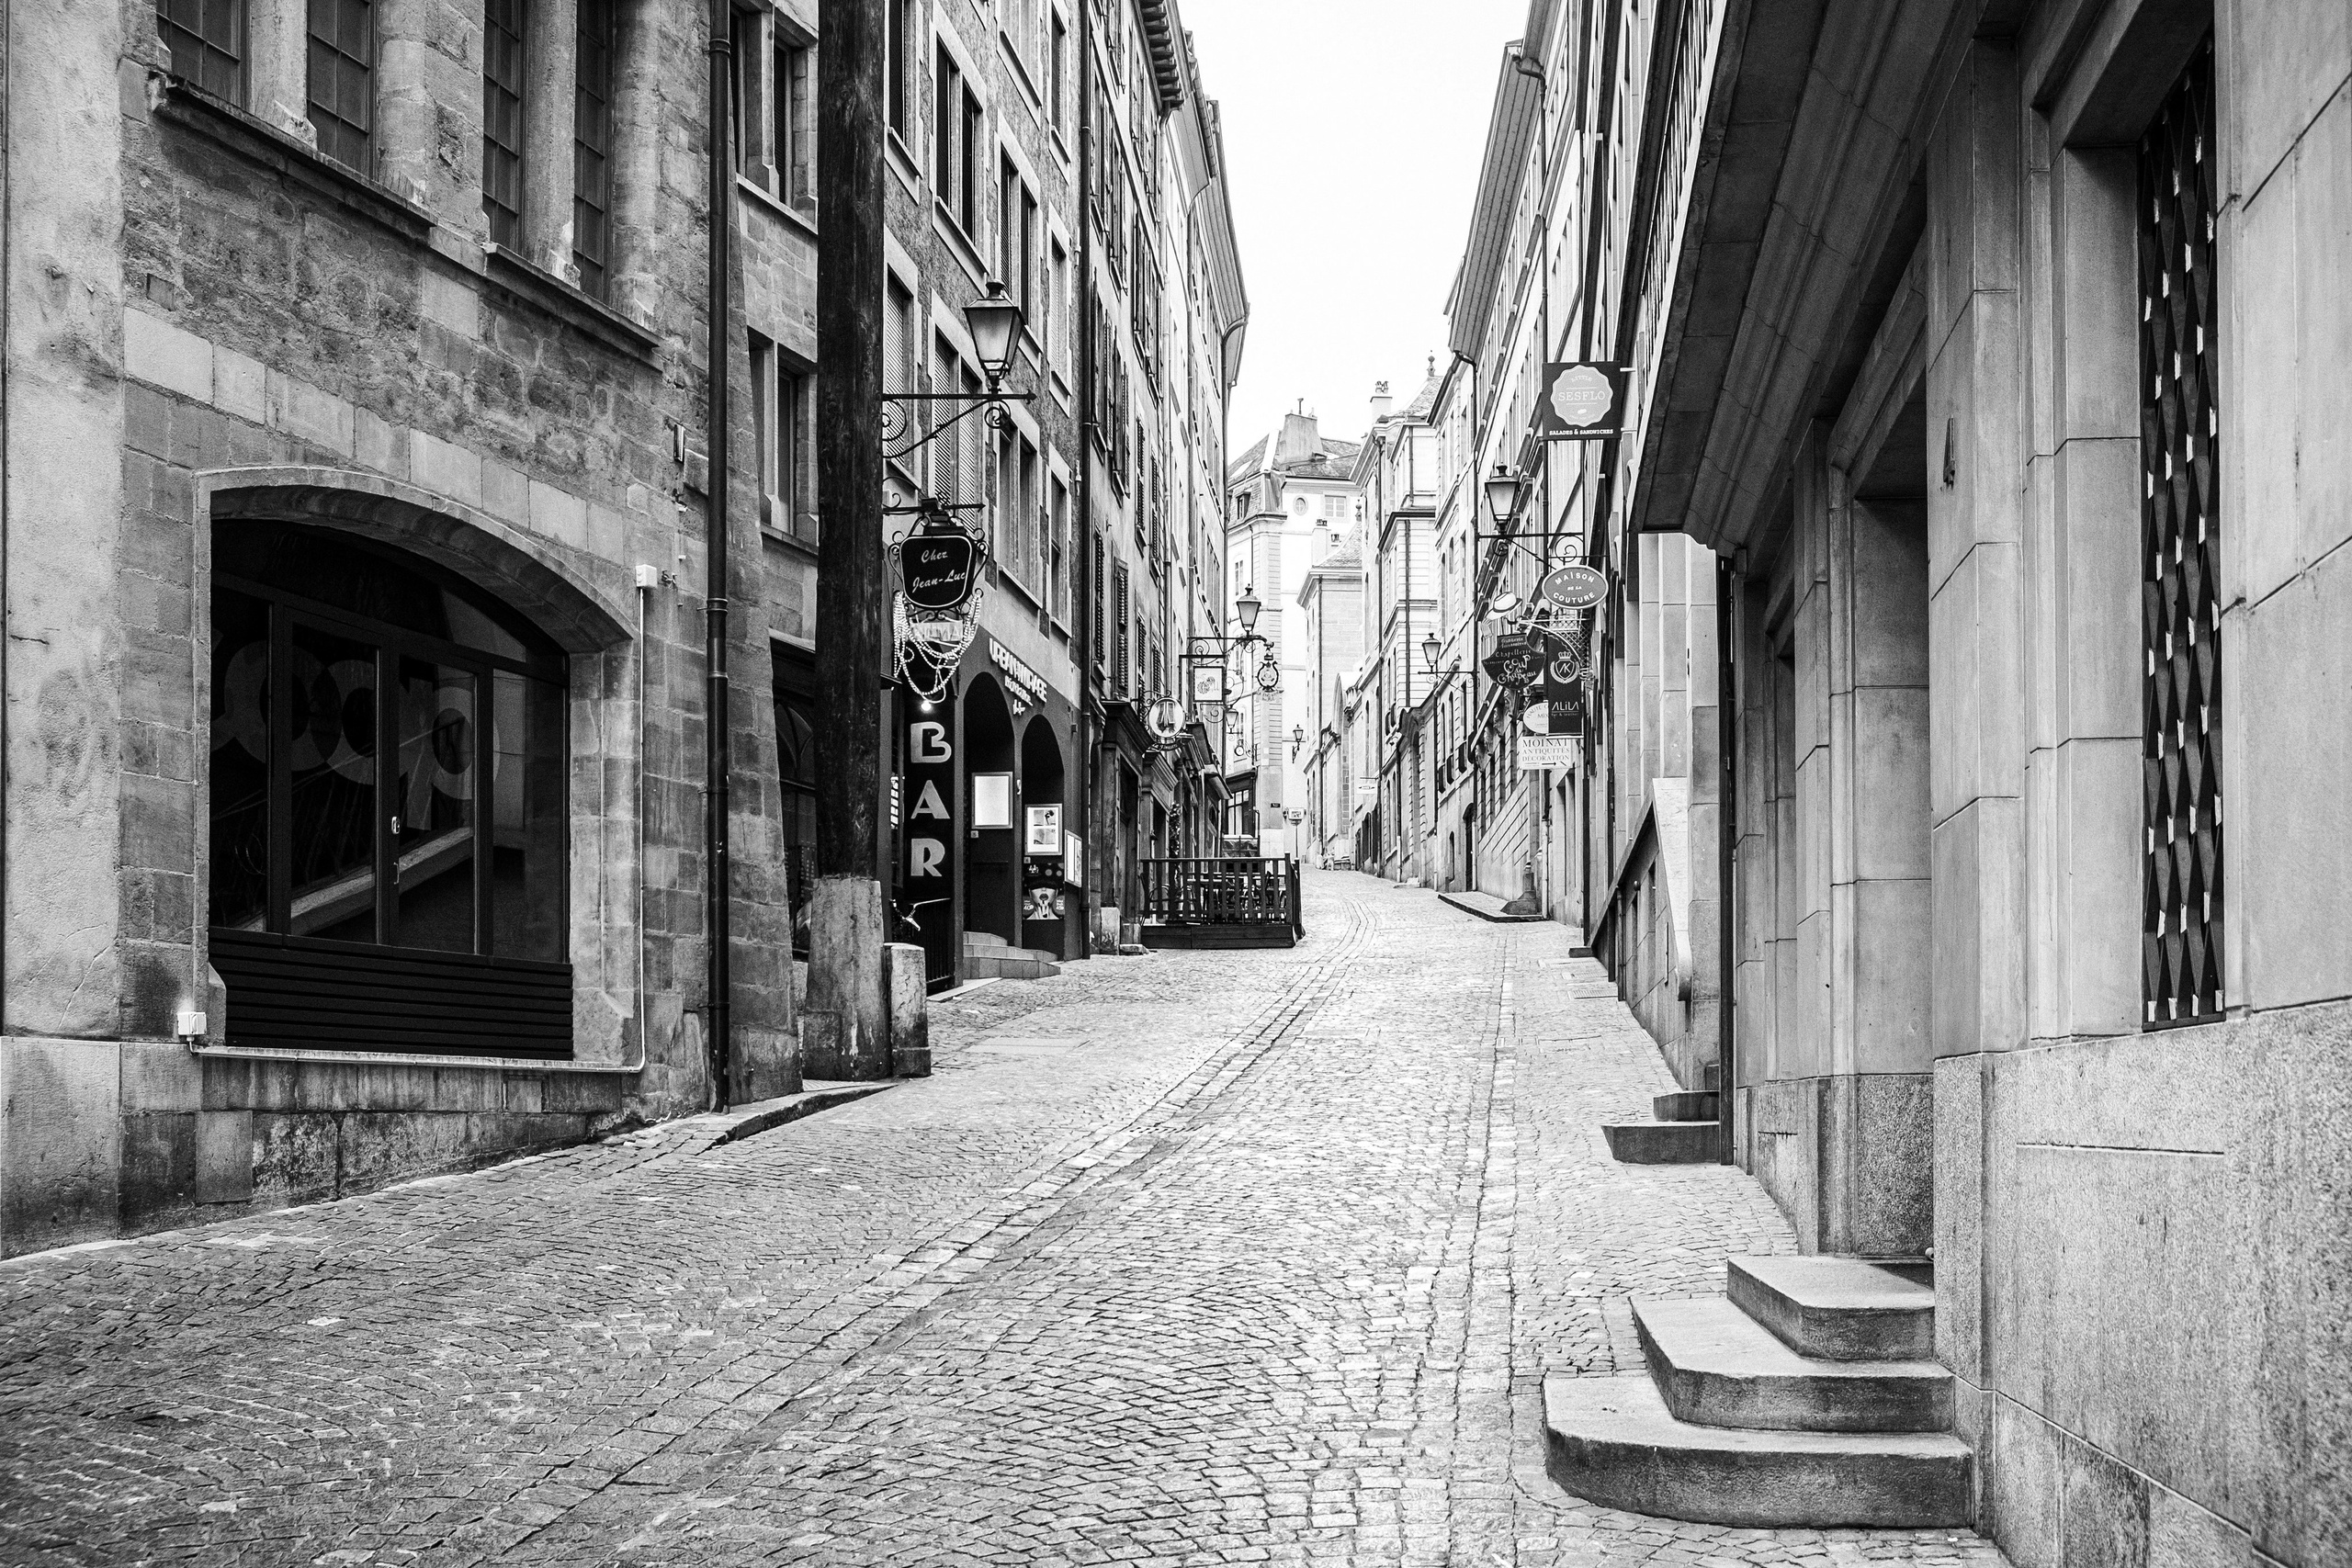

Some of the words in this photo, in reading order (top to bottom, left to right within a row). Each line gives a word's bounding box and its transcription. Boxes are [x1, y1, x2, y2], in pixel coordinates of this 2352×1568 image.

[1558, 390, 1606, 401] SESFLO
[921, 548, 949, 563] Chez
[911, 569, 967, 593] Jean-Luc
[1553, 592, 1595, 604] COUTURE
[207, 627, 501, 832] oop
[1522, 738, 1567, 748] MOINAT
[1522, 747, 1570, 755] ANTIQUITÉS
[1521, 754, 1570, 762] DÉCORATION
[910, 720, 953, 877] BAR
